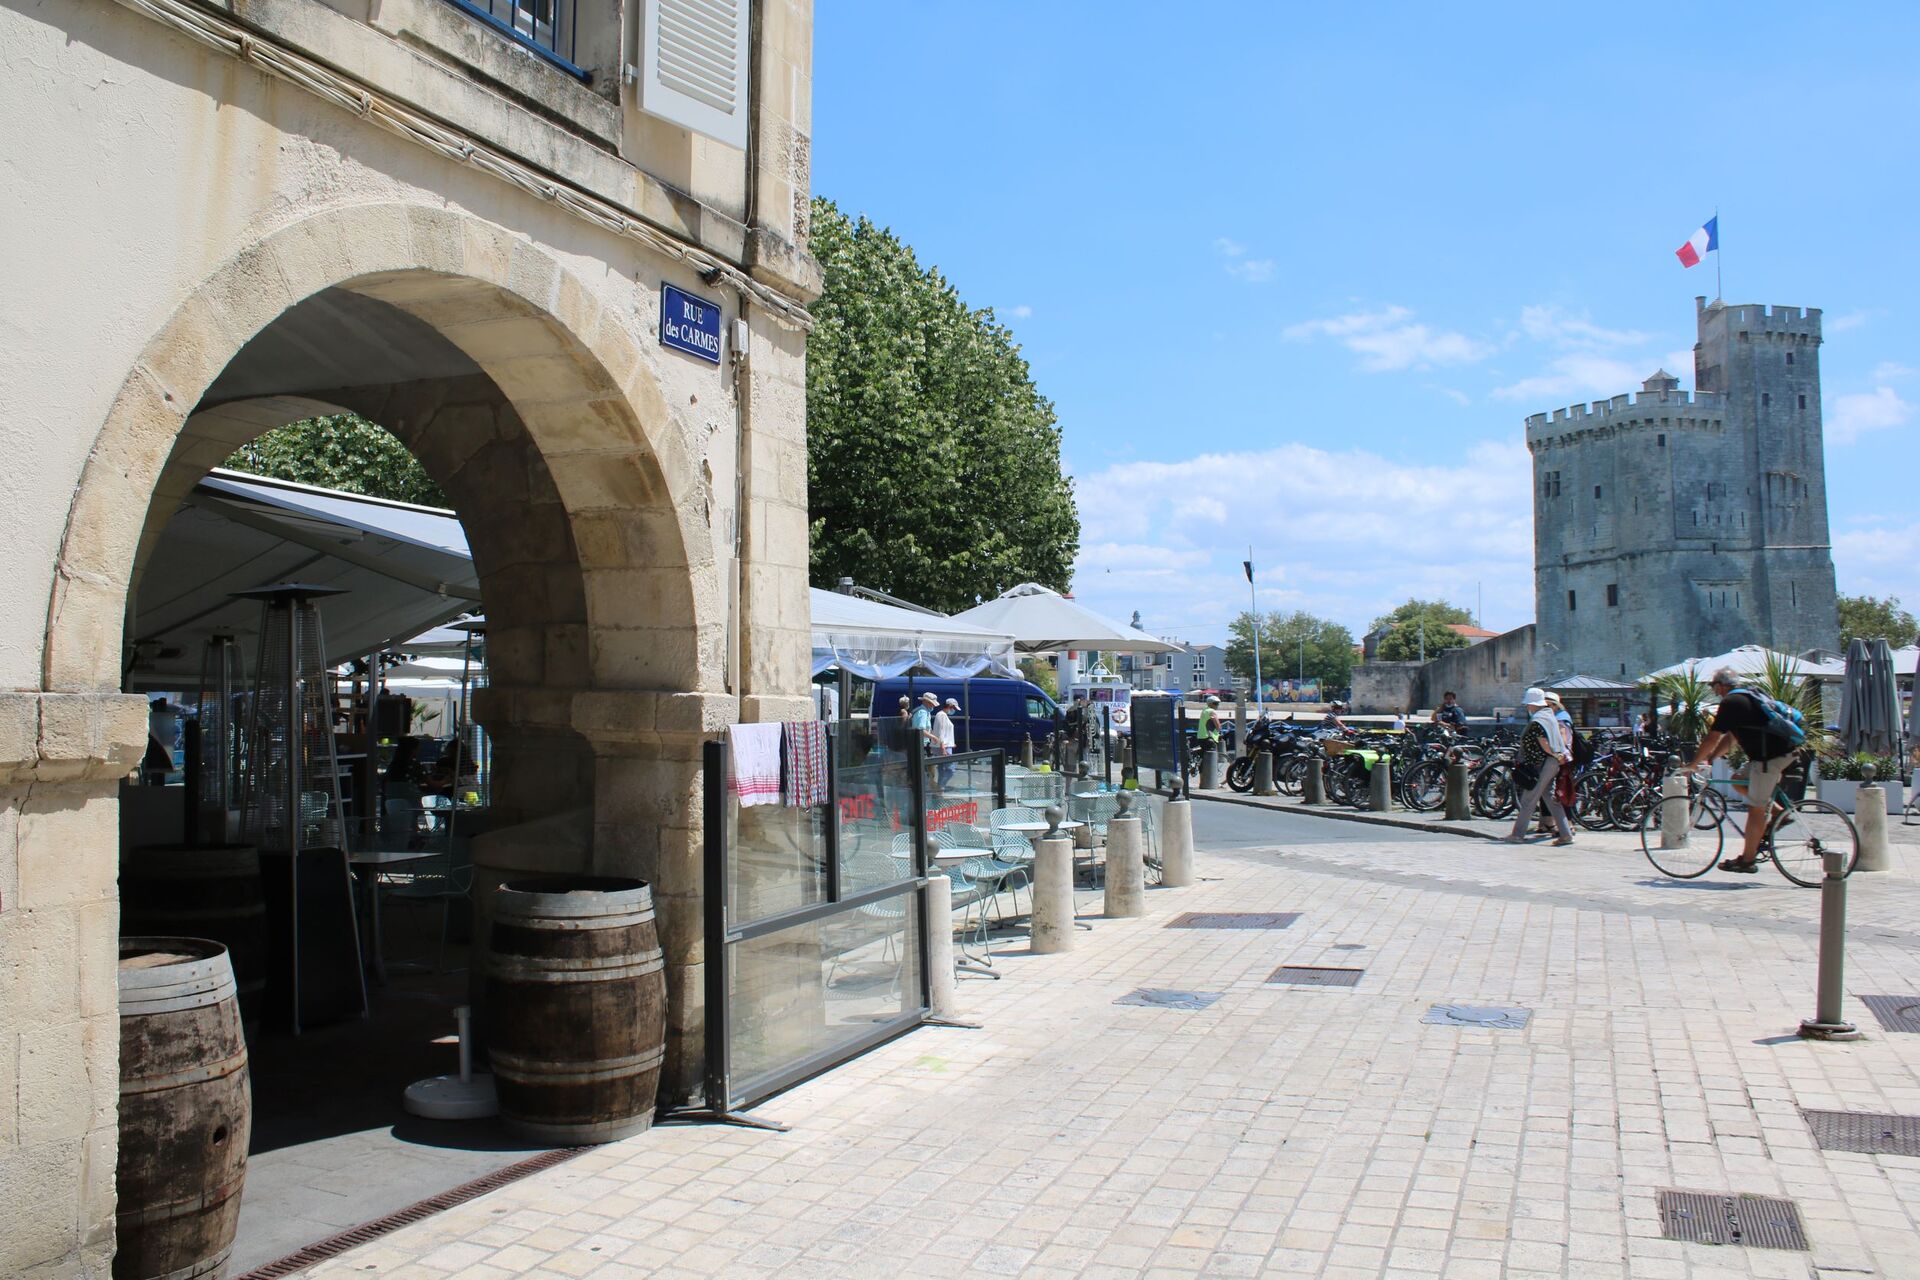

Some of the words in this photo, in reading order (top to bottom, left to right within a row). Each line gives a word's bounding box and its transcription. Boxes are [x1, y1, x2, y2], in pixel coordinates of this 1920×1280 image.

[683, 301, 703, 324] RUE
[666, 317, 679, 339] des
[681, 325, 718, 353] CARMES
